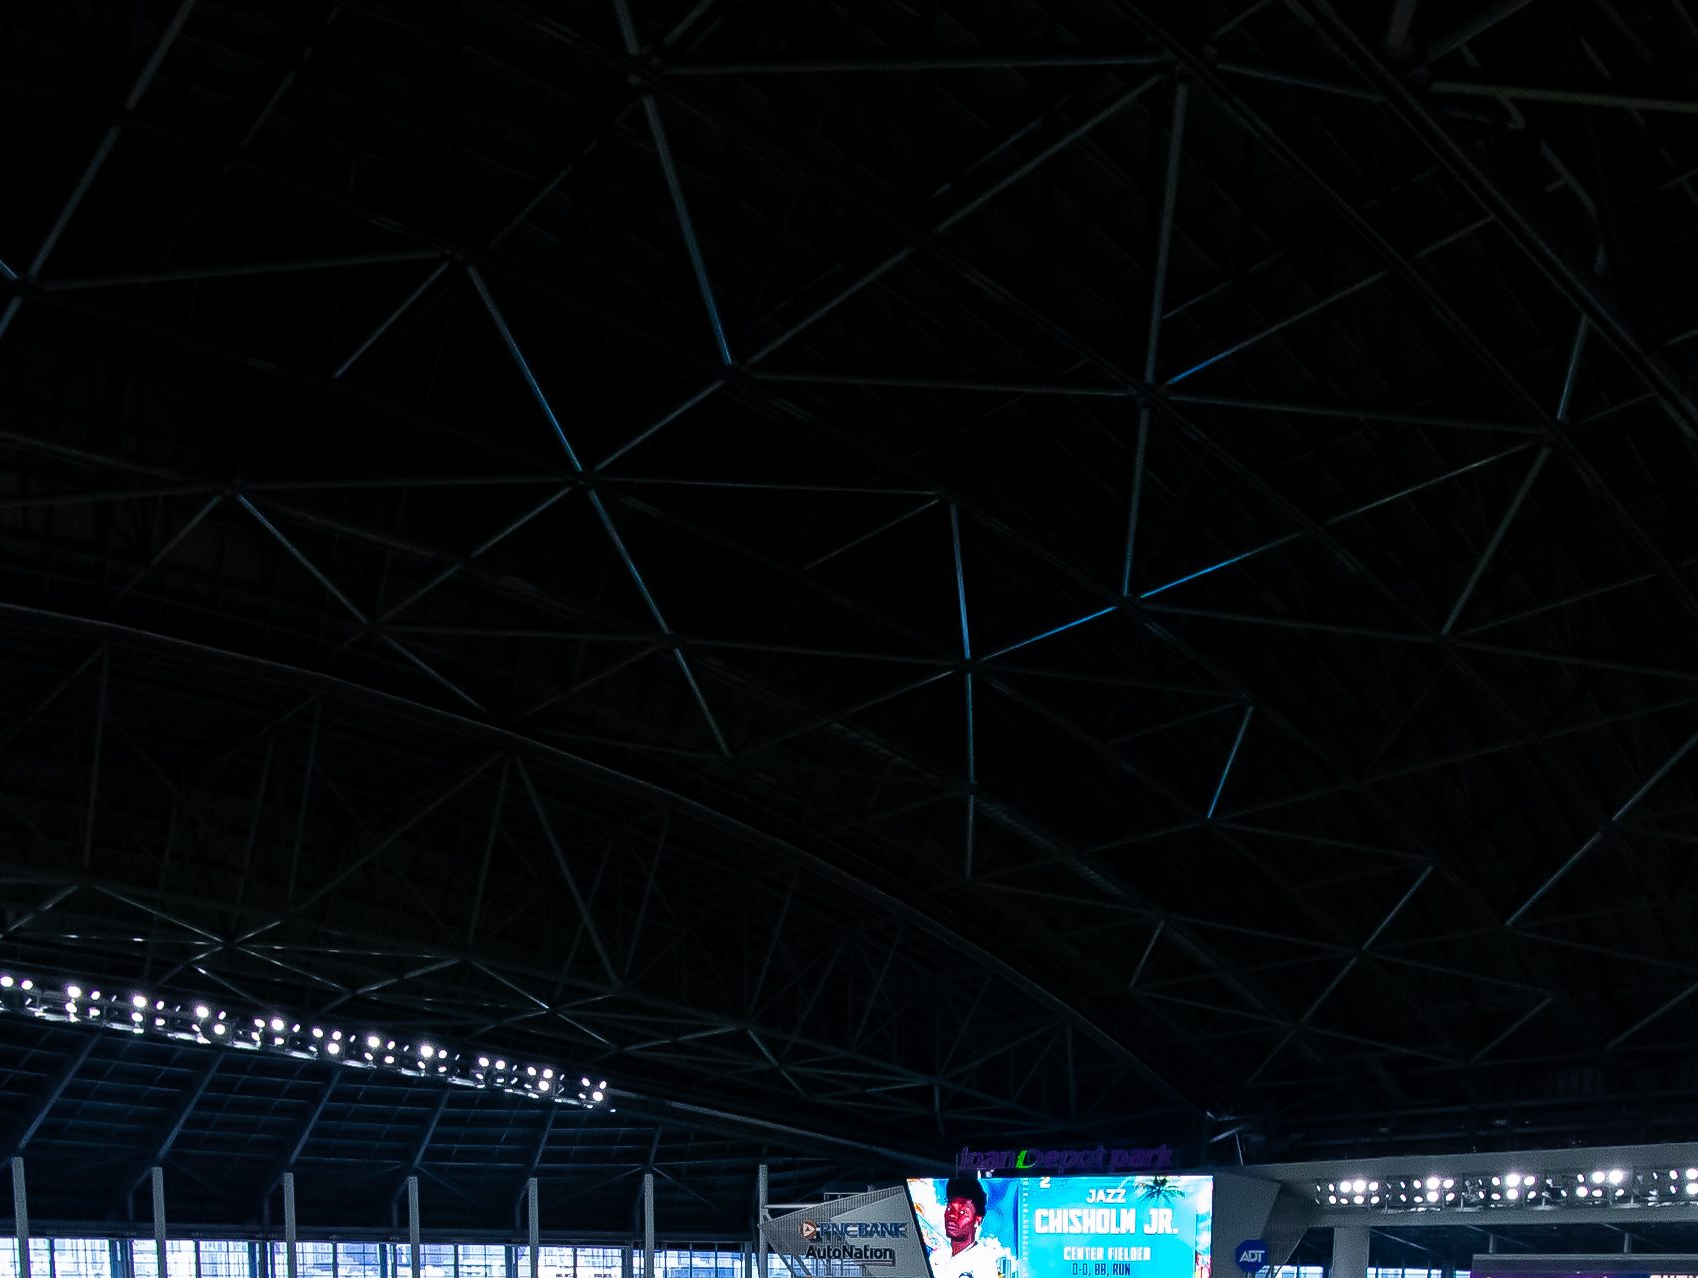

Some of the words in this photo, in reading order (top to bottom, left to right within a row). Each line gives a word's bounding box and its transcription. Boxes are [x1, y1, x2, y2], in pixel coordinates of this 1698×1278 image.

[958, 1146, 1105, 1172] loanDepot
[1109, 1144, 1173, 1172] park
[1086, 1189, 1126, 1203] JAZZ
[1035, 1208, 1136, 1235] CHISHOLM
[1143, 1208, 1179, 1235] JR.
[805, 1245, 894, 1259] AutoNation
[1063, 1247, 1103, 1261] CENTER
[1108, 1247, 1151, 1261] FIELDER
[1239, 1250, 1265, 1262] ADT
[1112, 1263, 1131, 1276] RUN
